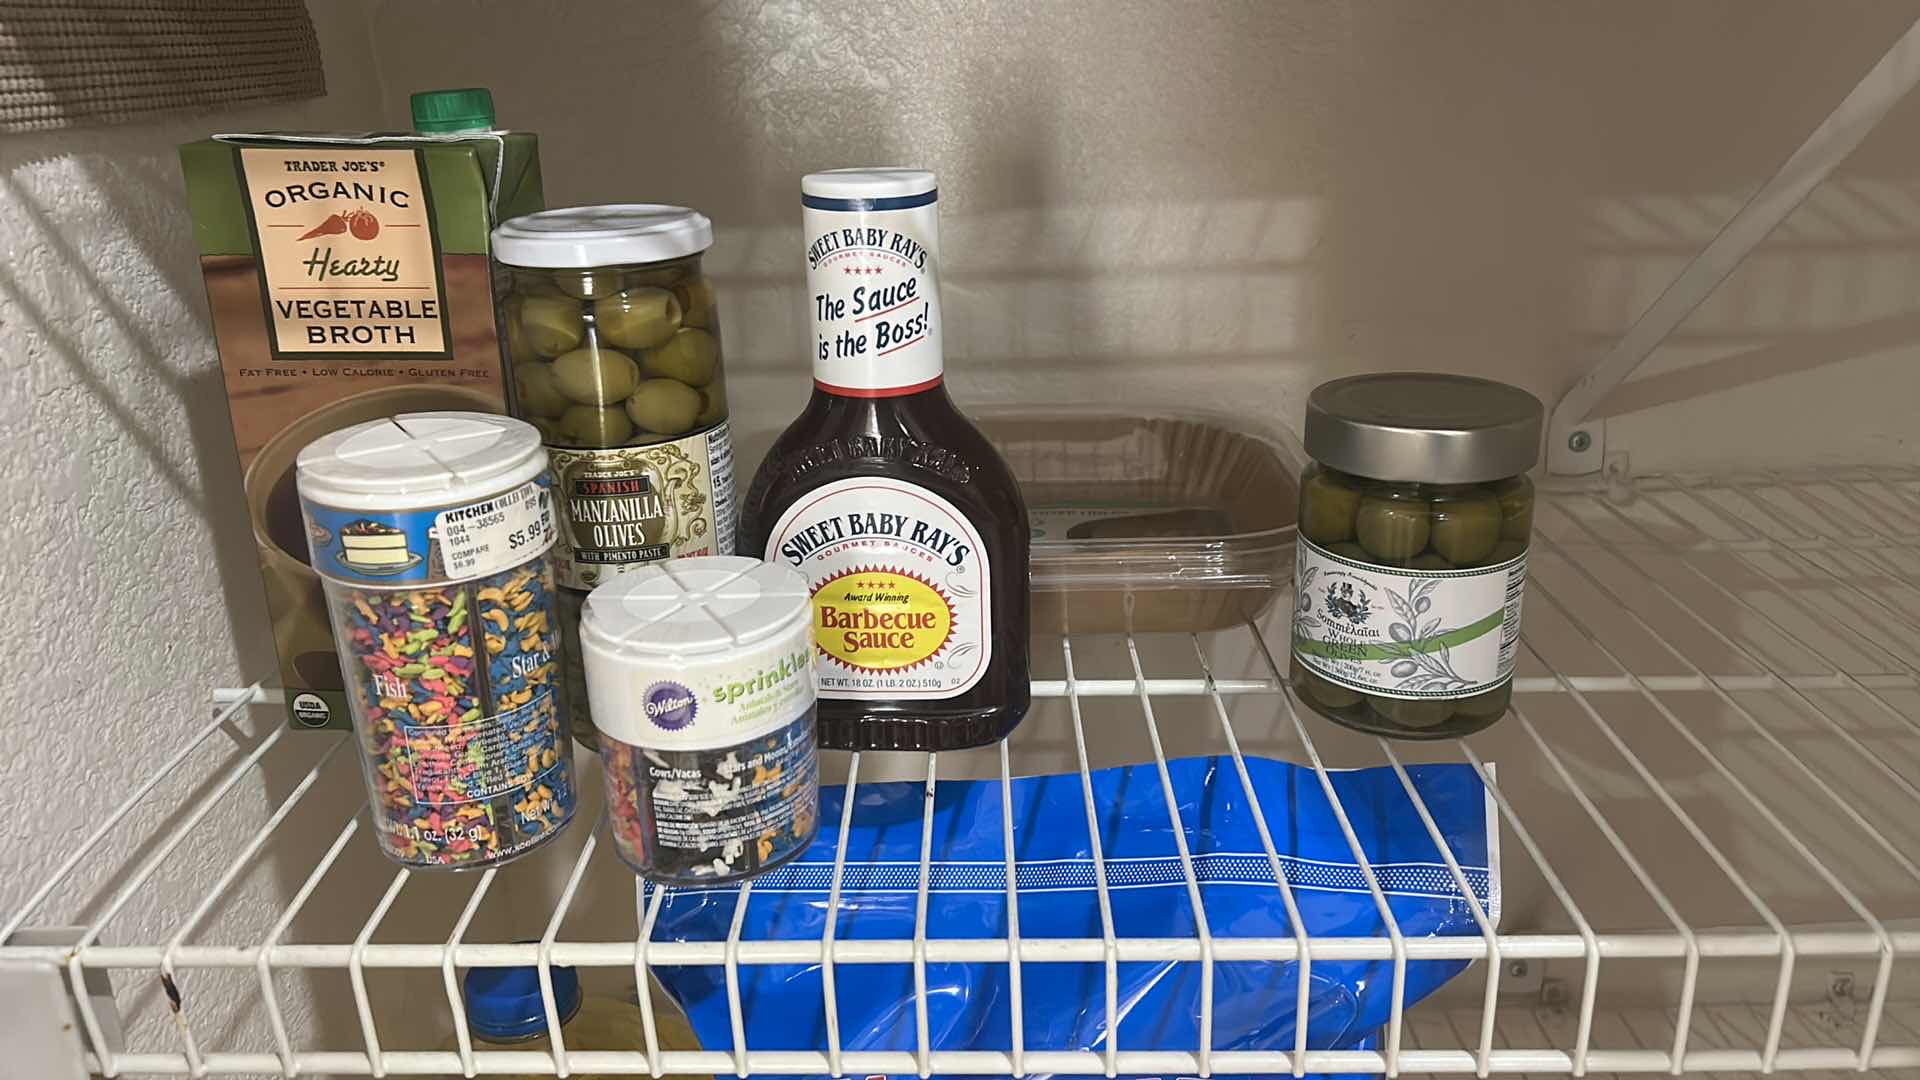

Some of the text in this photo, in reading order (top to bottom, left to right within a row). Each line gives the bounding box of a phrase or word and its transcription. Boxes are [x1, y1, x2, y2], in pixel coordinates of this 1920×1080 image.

[284, 160, 338, 173] TRADER
[264, 181, 410, 208] ORGANIC
[807, 228, 928, 270] SWEET BABY RAY'S
[303, 247, 401, 282] Hearty
[276, 300, 439, 320] VEGETABLE
[816, 277, 917, 321] The Sauce
[306, 325, 416, 344] BROTH
[818, 302, 929, 360] is the Boss!
[583, 480, 640, 493] SPANISH
[445, 501, 494, 524] KITCHEN
[570, 495, 664, 523] MANZANILLA
[508, 520, 542, 550] $5.99
[593, 522, 646, 548] OLIVES
[780, 516, 847, 567] SWEET
[847, 512, 909, 538] BABY
[909, 520, 971, 568] RAY'S
[581, 548, 661, 560] WITH PIMENTO PASTE
[816, 540, 876, 561] GOURMET
[844, 592, 910, 604] Award Winning
[820, 605, 936, 630] Barbecue
[842, 631, 915, 654] Sauce
[512, 655, 540, 679] Star
[372, 673, 407, 698] Fish
[820, 677, 836, 687] NET
[836, 677, 850, 687] WT.
[852, 678, 861, 687] 18
[899, 678, 905, 688] 2
[922, 678, 942, 689] 510g
[646, 695, 694, 717] Wilton
[649, 766, 702, 779] Cows/Vacas
[424, 830, 443, 842] oz.
[445, 826, 465, 844] (32
[468, 825, 482, 843] g)
